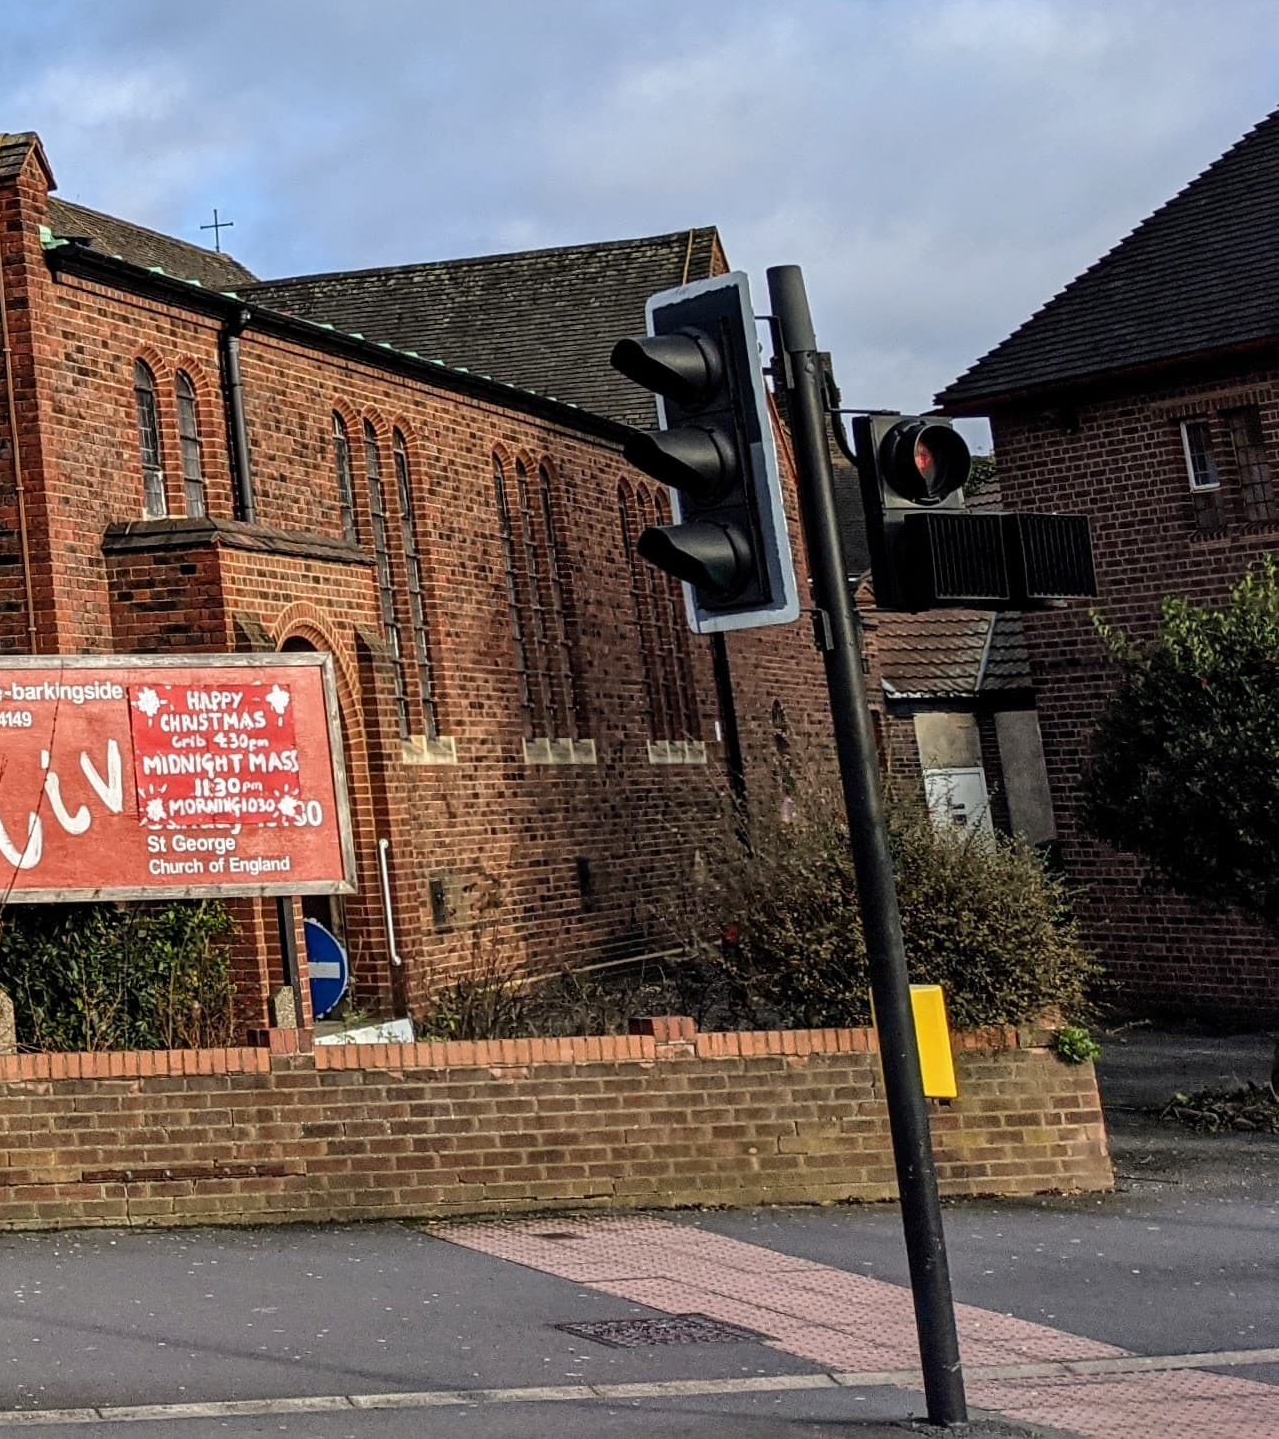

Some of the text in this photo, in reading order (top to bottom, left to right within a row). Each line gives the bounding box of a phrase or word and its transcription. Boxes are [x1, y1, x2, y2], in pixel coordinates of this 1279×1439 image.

[186, 690, 243, 711] HAPPY
[160, 711, 266, 732] CHRISTMAS
[143, 750, 299, 778] MIDNIGHT MASS
[169, 798, 241, 817] MORNING
[147, 836, 236, 855] St George
[149, 856, 291, 875] Church of England
